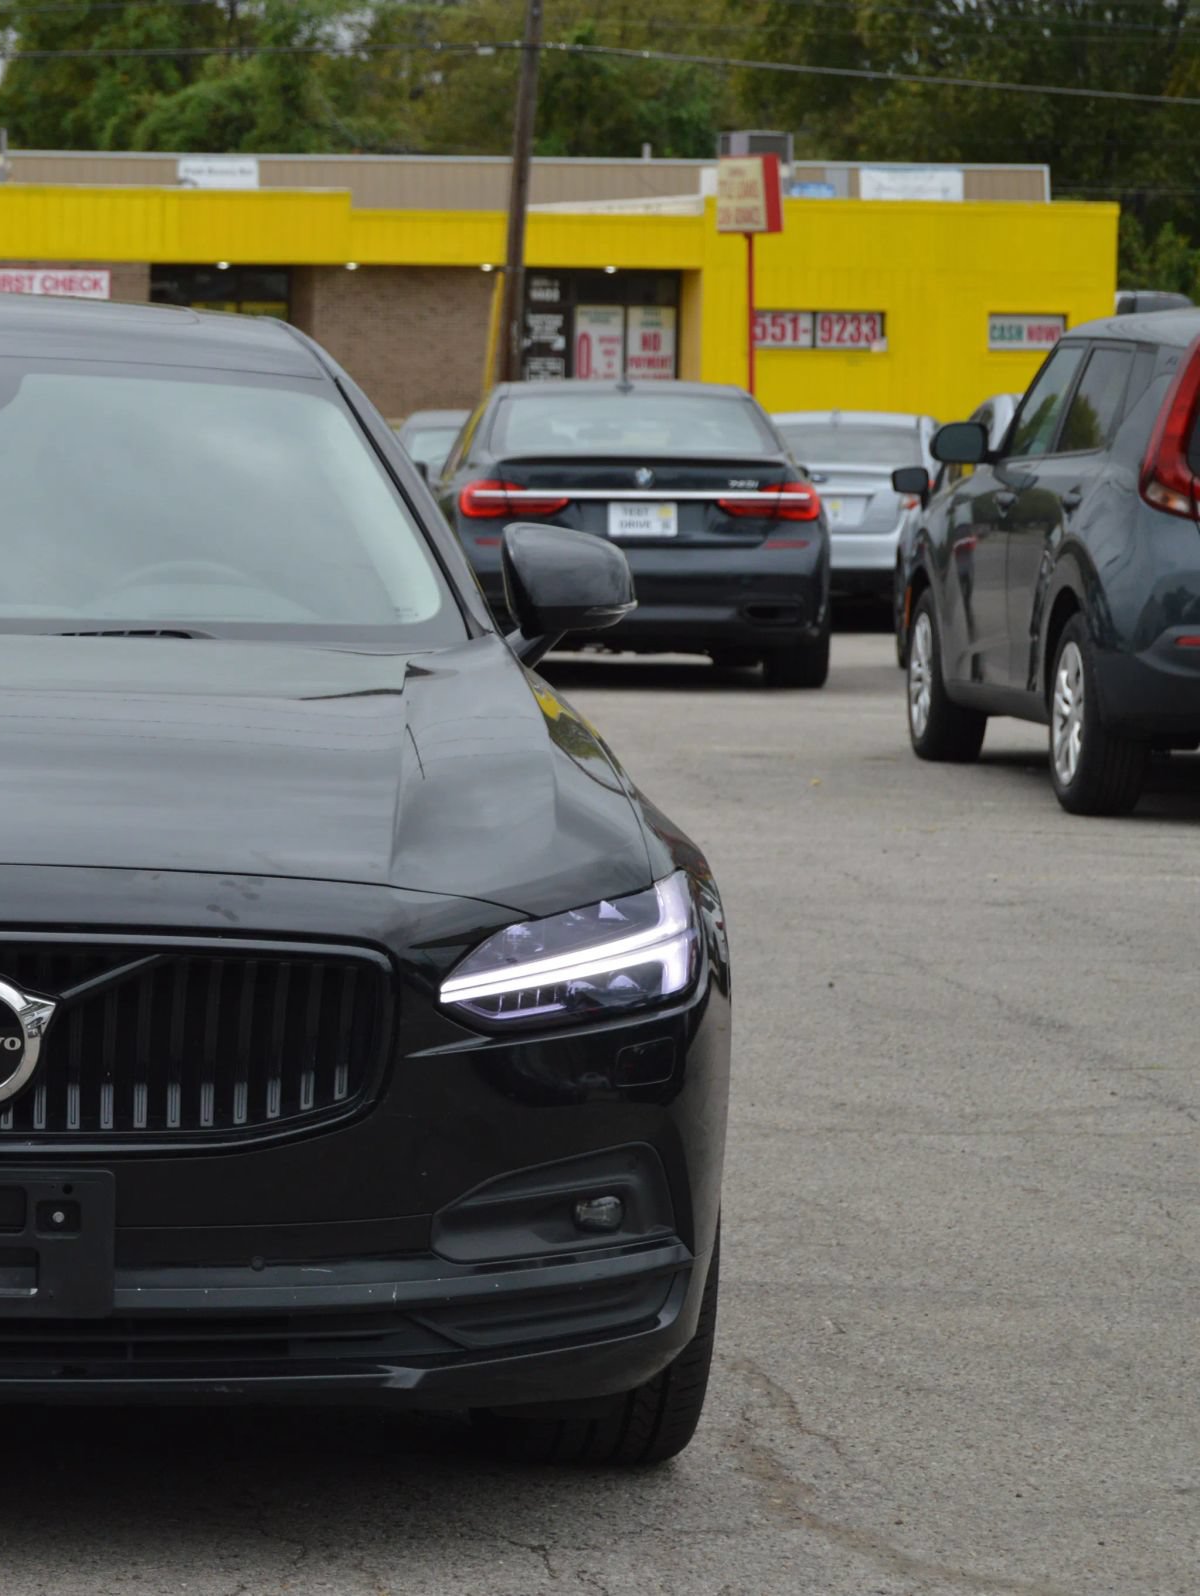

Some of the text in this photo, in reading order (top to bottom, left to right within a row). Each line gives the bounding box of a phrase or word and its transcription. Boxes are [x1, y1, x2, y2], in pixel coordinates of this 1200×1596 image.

[41, 273, 103, 292] CHECK
[820, 313, 878, 343] 9233
[990, 323, 1024, 341] CASH
